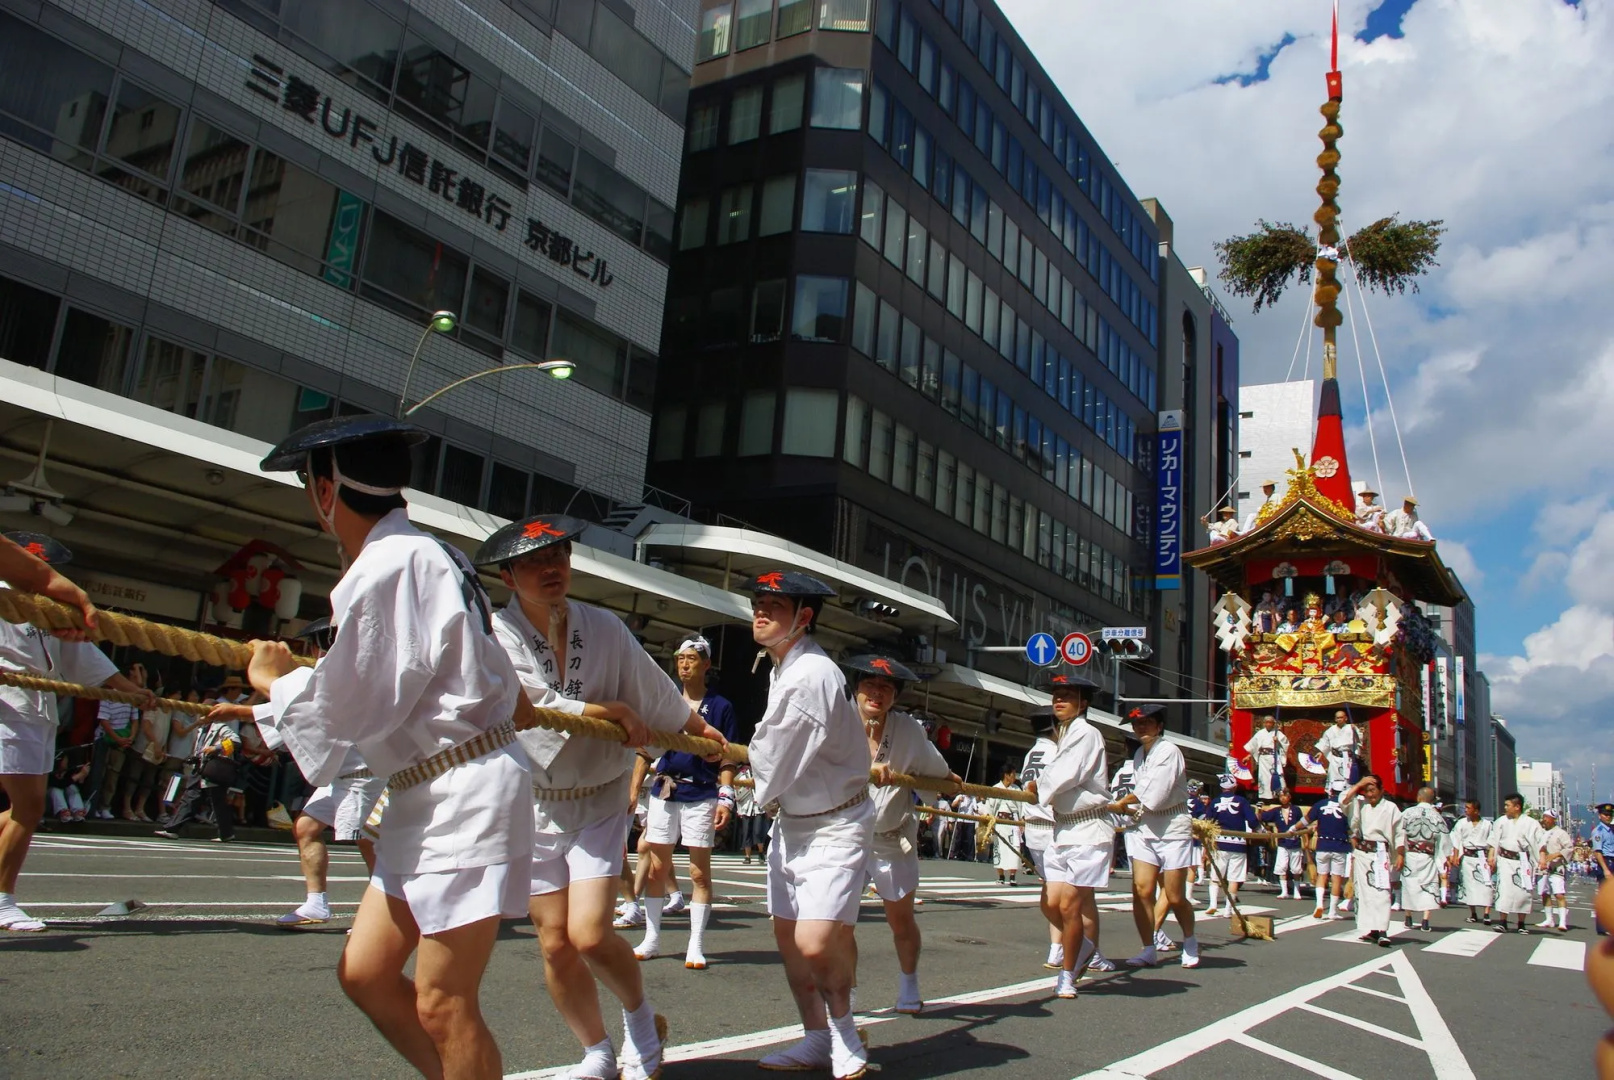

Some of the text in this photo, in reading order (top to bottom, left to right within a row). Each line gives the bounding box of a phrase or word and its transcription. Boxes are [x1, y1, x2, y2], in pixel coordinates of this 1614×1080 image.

[245, 54, 613, 286] 三菱UFJ信託銀行 京都ビル
[1160, 438, 1177, 567] リカーマウンテン
[564, 630, 584, 700] 長刀鉾
[1068, 642, 1085, 656] 40
